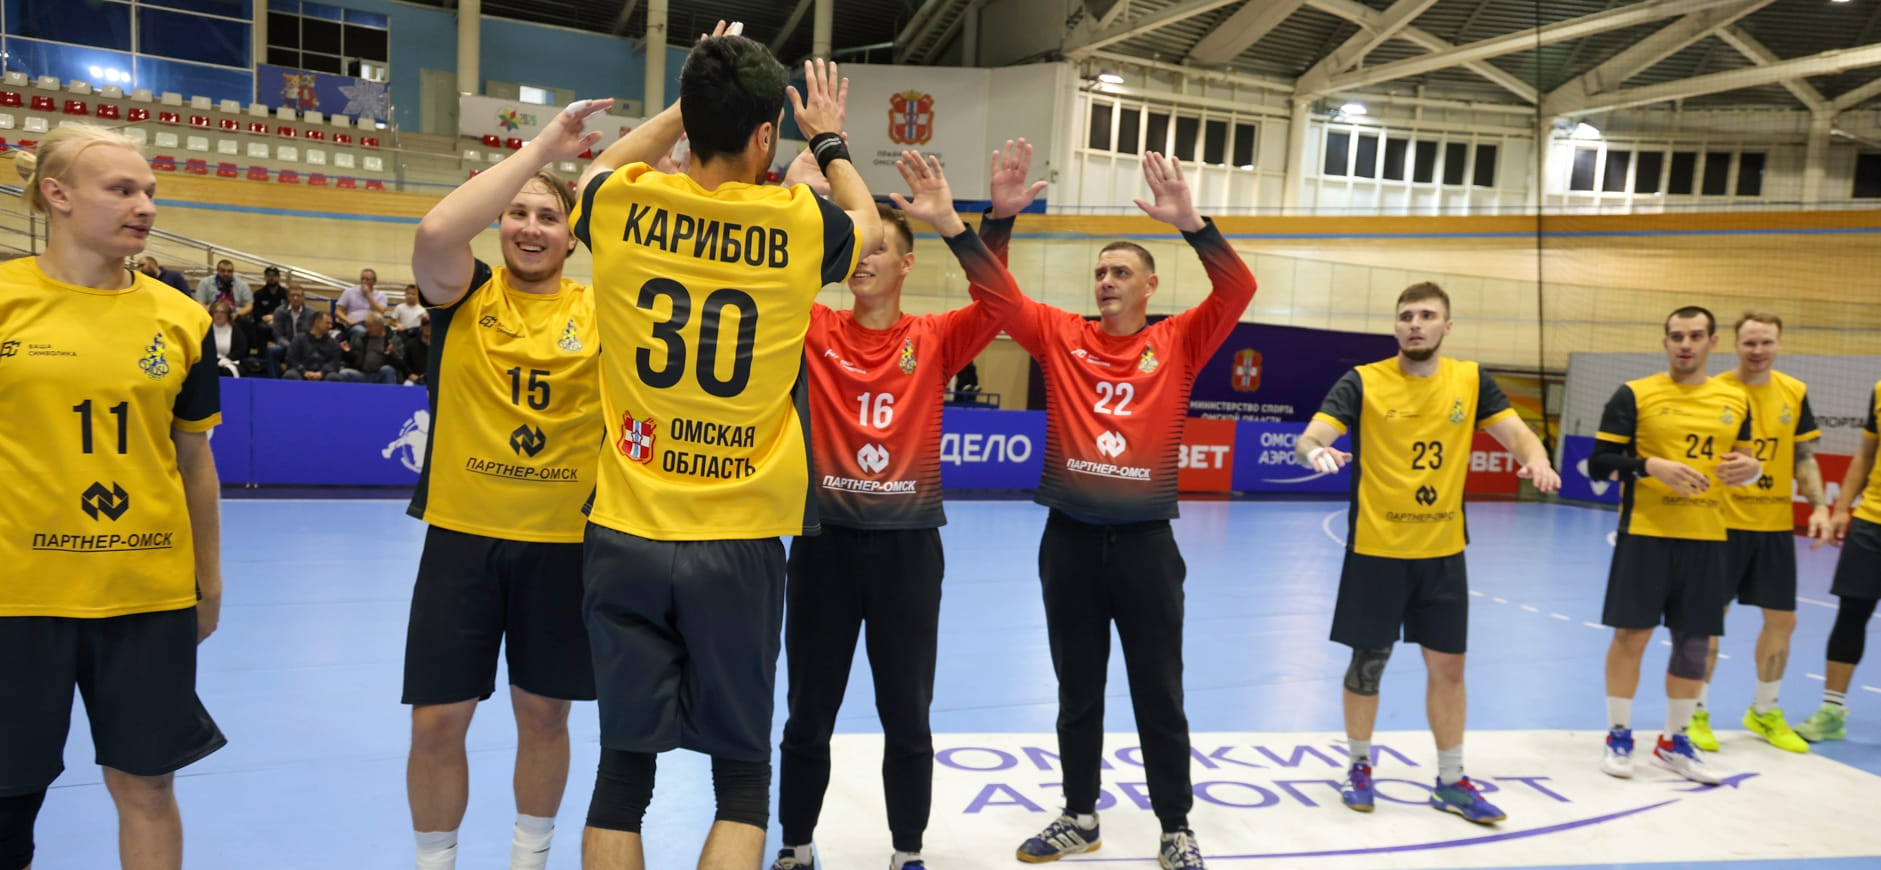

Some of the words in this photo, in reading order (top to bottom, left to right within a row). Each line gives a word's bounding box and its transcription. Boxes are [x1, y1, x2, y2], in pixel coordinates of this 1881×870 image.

[622, 202, 789, 269] КАРИБОВ
[635, 277, 759, 398] 30
[506, 366, 551, 410] 15
[1093, 381, 1135, 416] 22
[857, 391, 895, 430] 16
[1189, 400, 1260, 413] МИНИСТЕРСТВО
[1260, 403, 1294, 415] СПОРТА
[72, 399, 129, 454] 11
[670, 417, 756, 448] ОМСКАЯ
[940, 433, 1032, 466] ДЕЛО
[1411, 441, 1443, 470] 23
[1685, 433, 1714, 460] 24
[1753, 437, 1779, 462] 27
[465, 457, 579, 480] ПАРТНЕР-ОМСК
[662, 449, 756, 480] ОБЛАСТЬ
[1066, 458, 1152, 478] ПАРТНЕР-ОМСК
[822, 475, 917, 491] ПАРТНЕР-ОМСК
[32, 532, 173, 549] ПАРТНЕР-ОМСК
